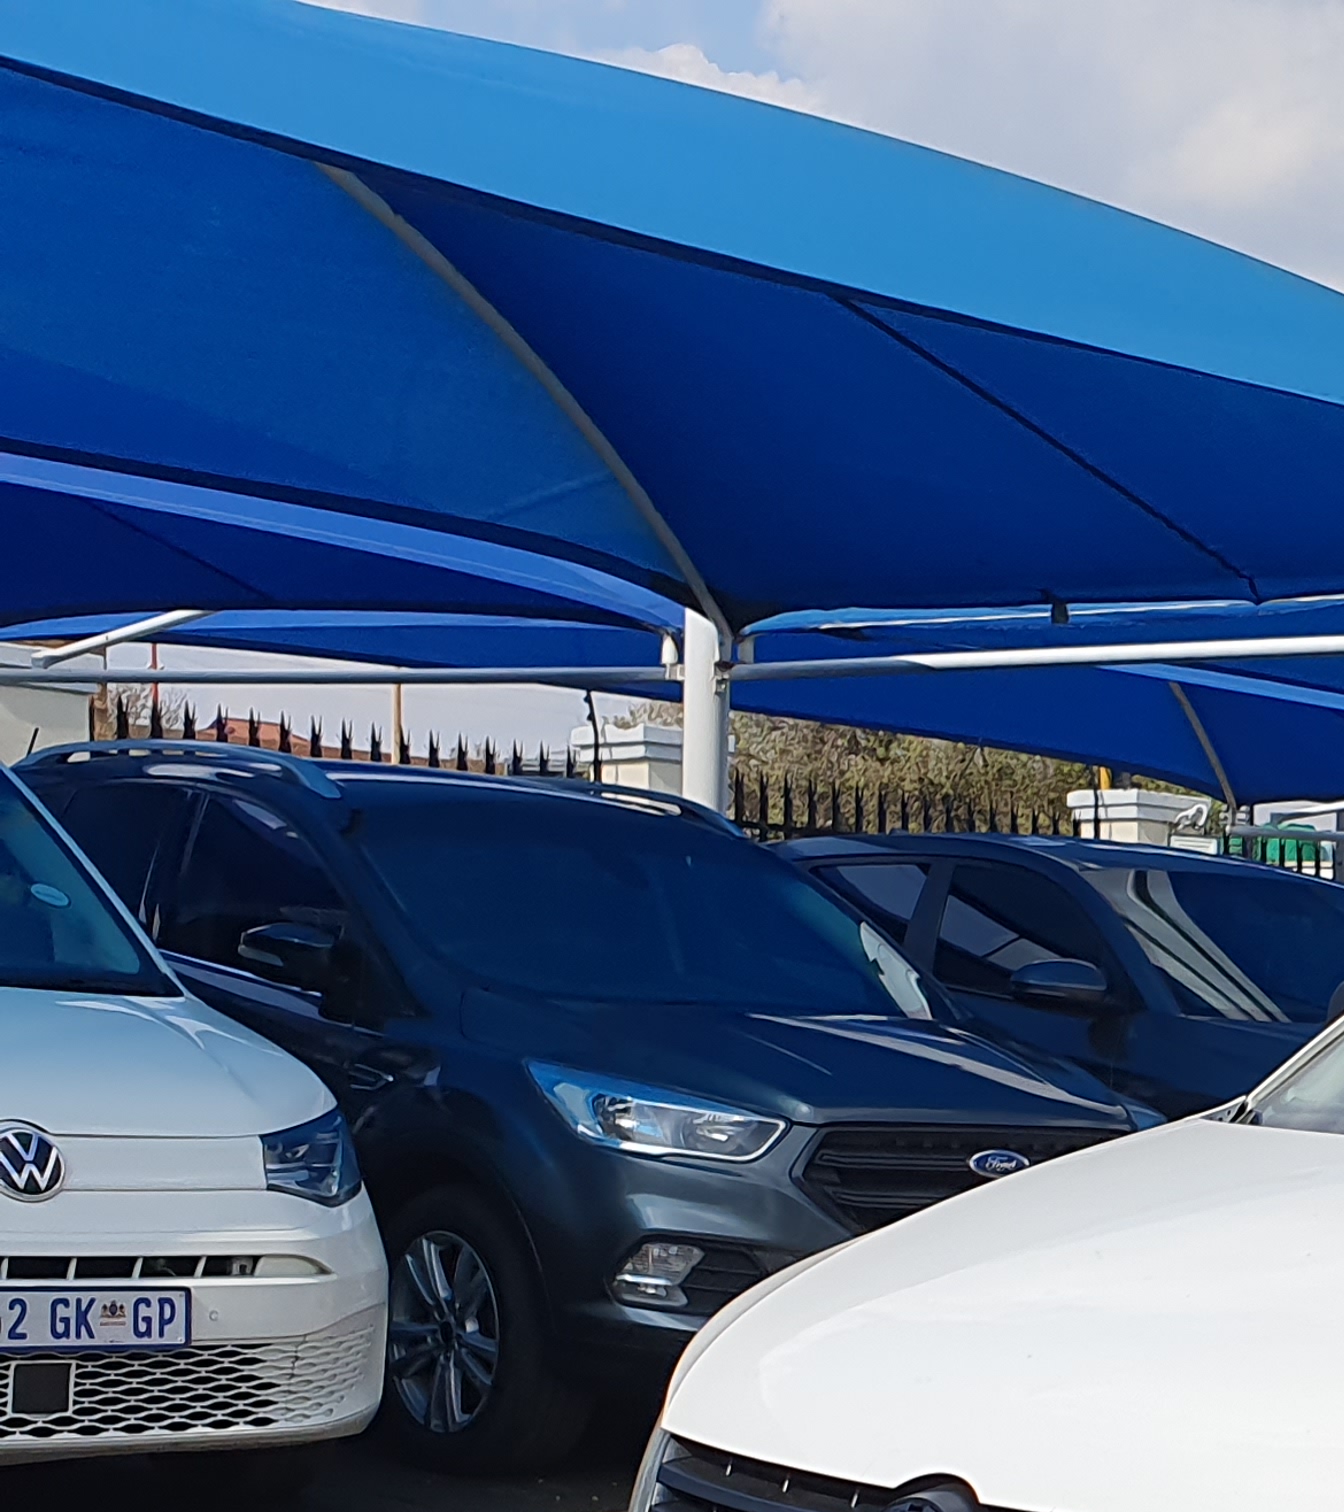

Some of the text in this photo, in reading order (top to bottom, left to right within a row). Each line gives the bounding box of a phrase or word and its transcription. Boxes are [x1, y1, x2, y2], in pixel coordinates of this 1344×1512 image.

[985, 1156, 1018, 1172] Ford
[0, 1297, 177, 1341] 2 GK GP
